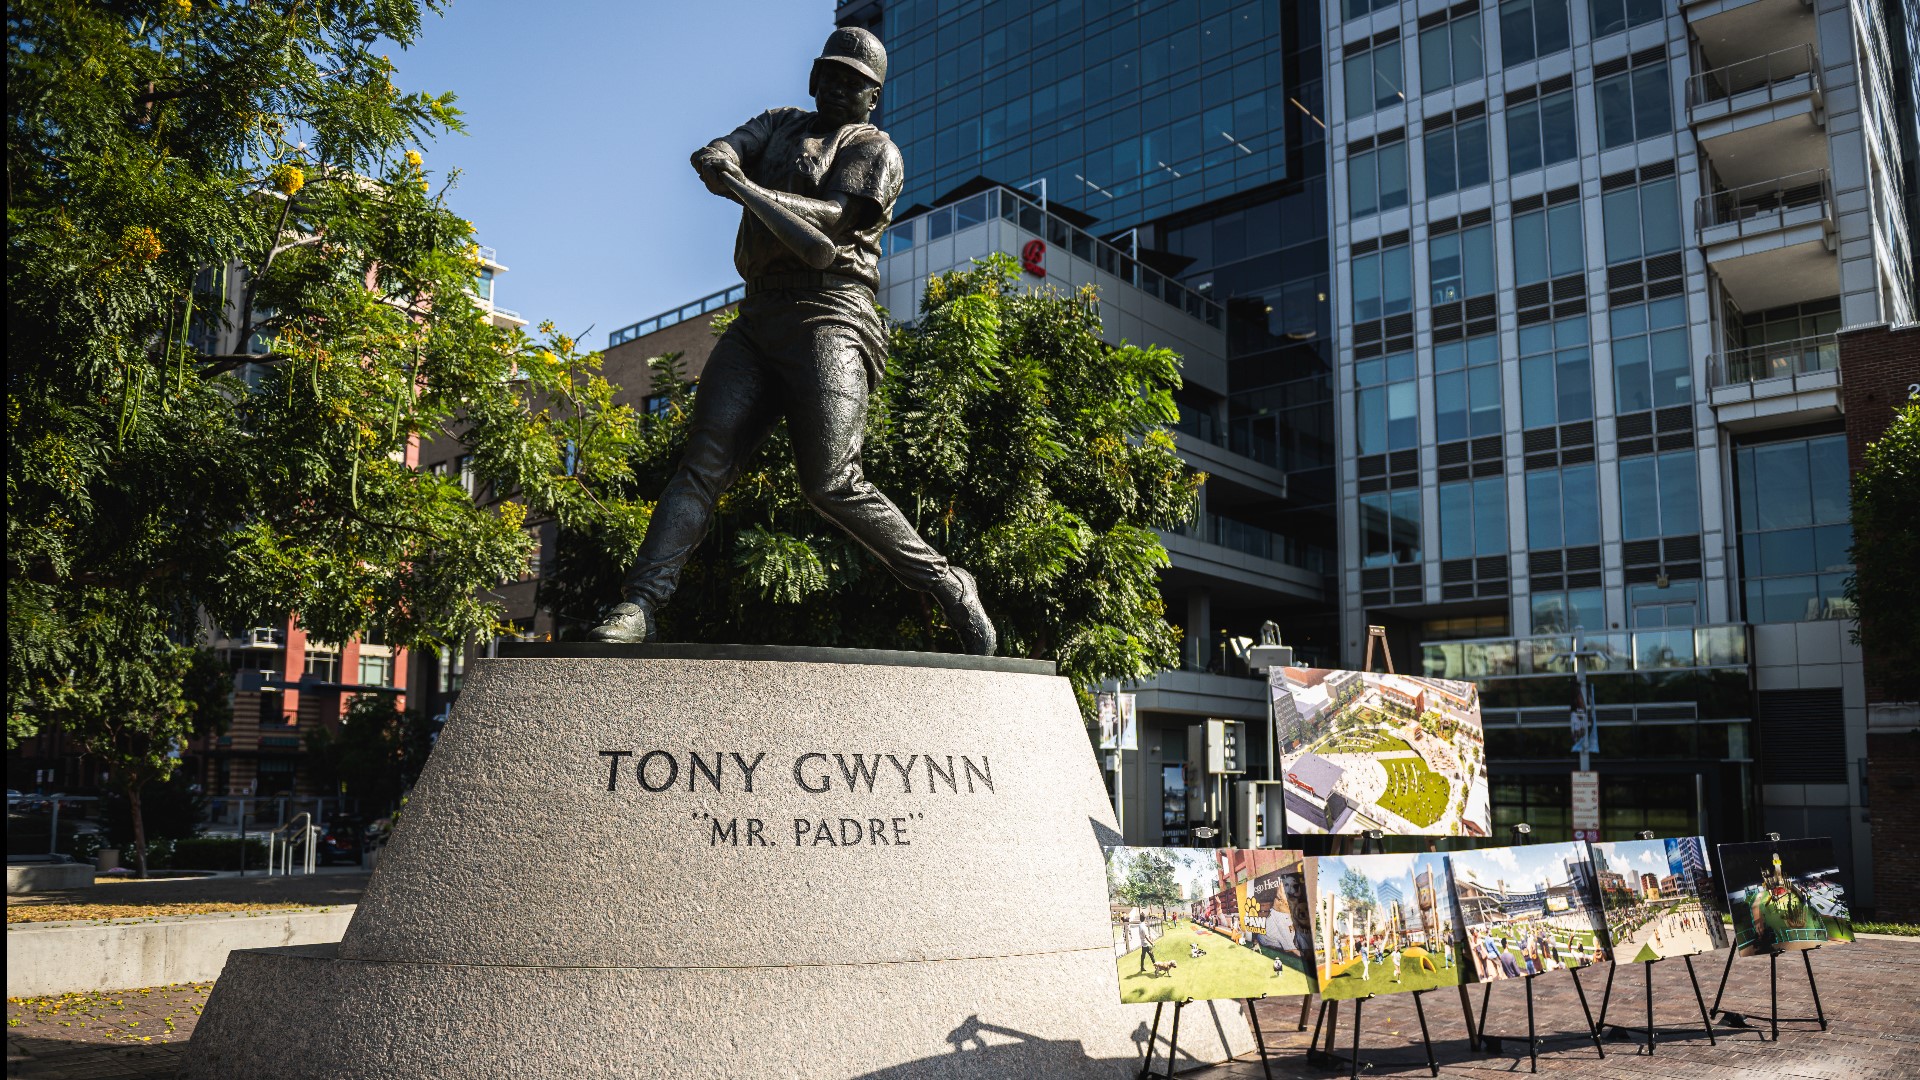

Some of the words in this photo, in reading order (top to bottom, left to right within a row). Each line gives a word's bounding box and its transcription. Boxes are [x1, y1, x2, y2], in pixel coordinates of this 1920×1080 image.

[599, 750, 766, 793] TONY
[793, 752, 995, 795] GWYNN
[1244, 916, 1267, 929] PAW
